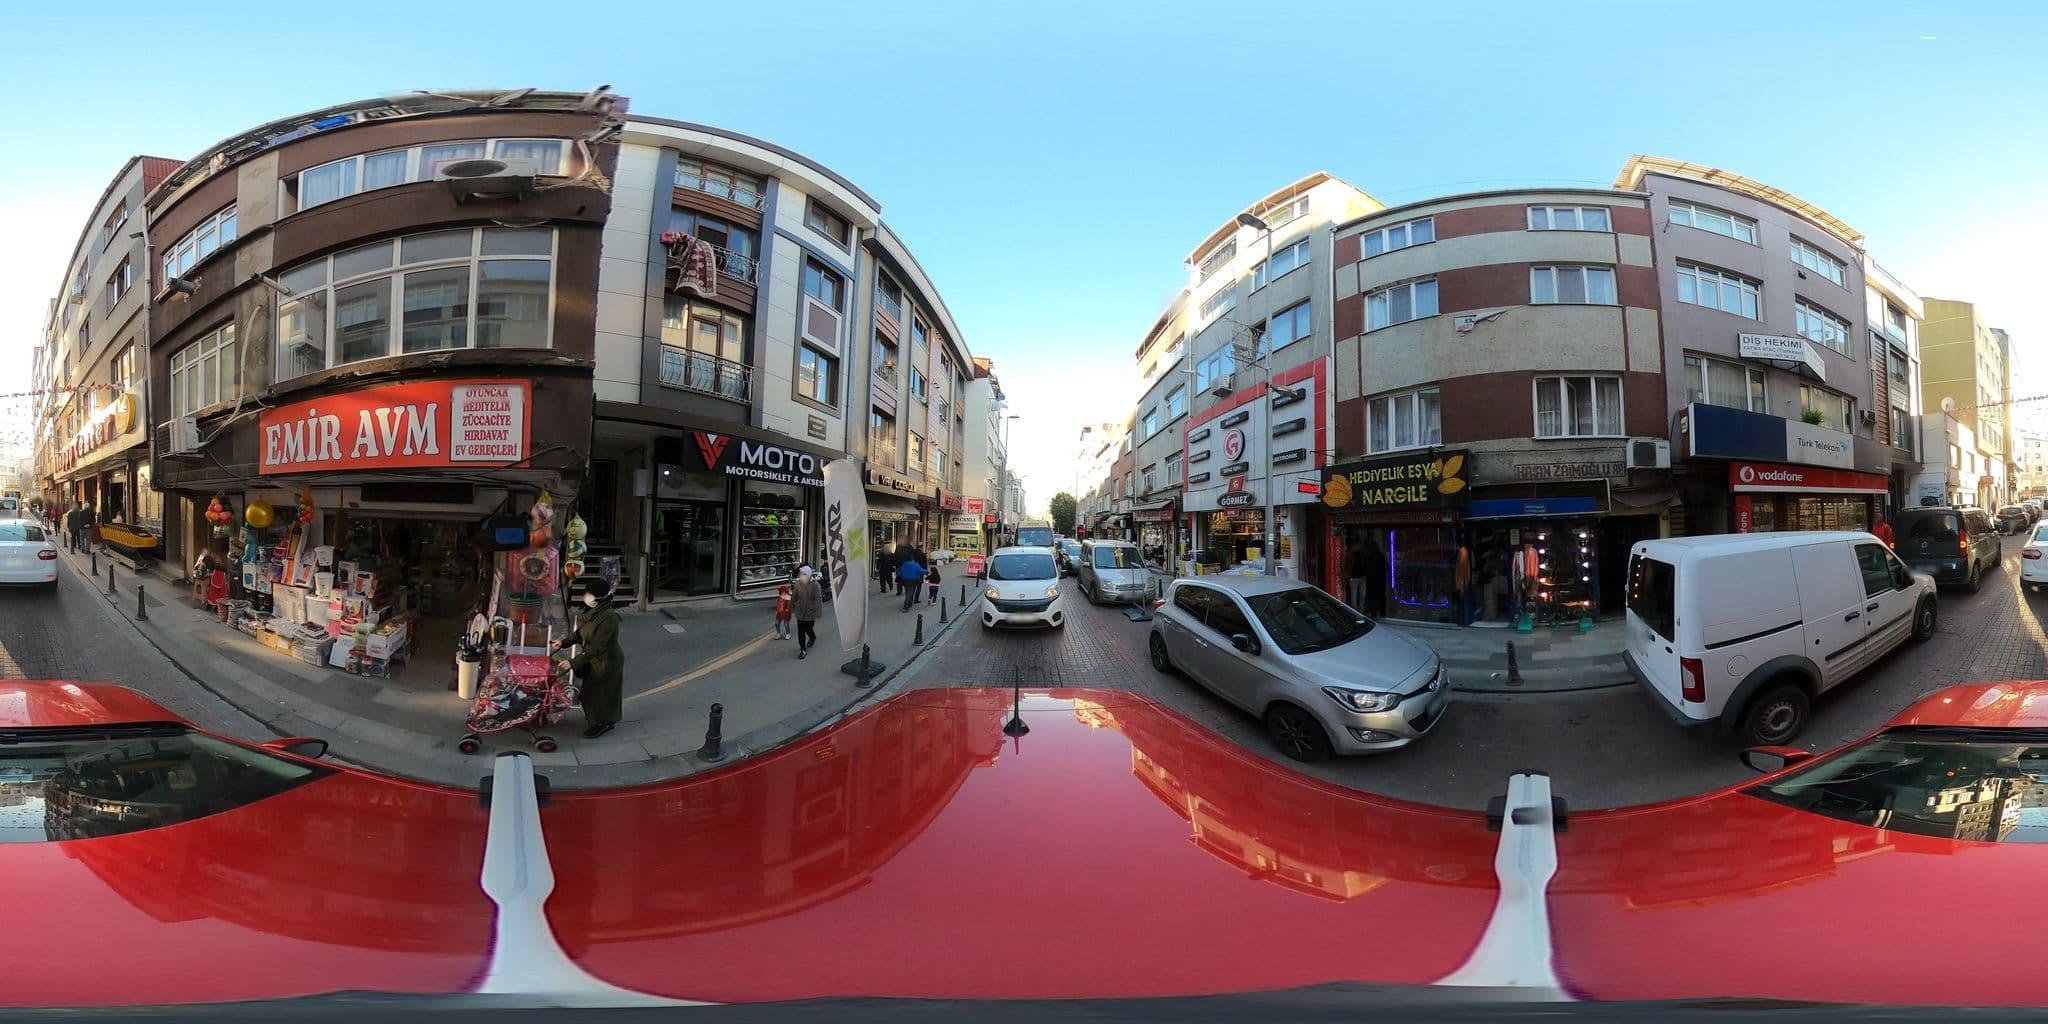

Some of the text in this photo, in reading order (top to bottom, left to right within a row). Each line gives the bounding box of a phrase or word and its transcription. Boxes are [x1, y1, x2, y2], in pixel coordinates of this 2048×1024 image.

[265, 403, 440, 466] EMİR AVM
[464, 429, 510, 441] HIRDAVAT
[455, 445, 466, 456] EV
[1815, 440, 1841, 452] Telekom
[740, 440, 815, 475] MOTO
[793, 475, 800, 483] &
[1758, 469, 1803, 482] vodafone
